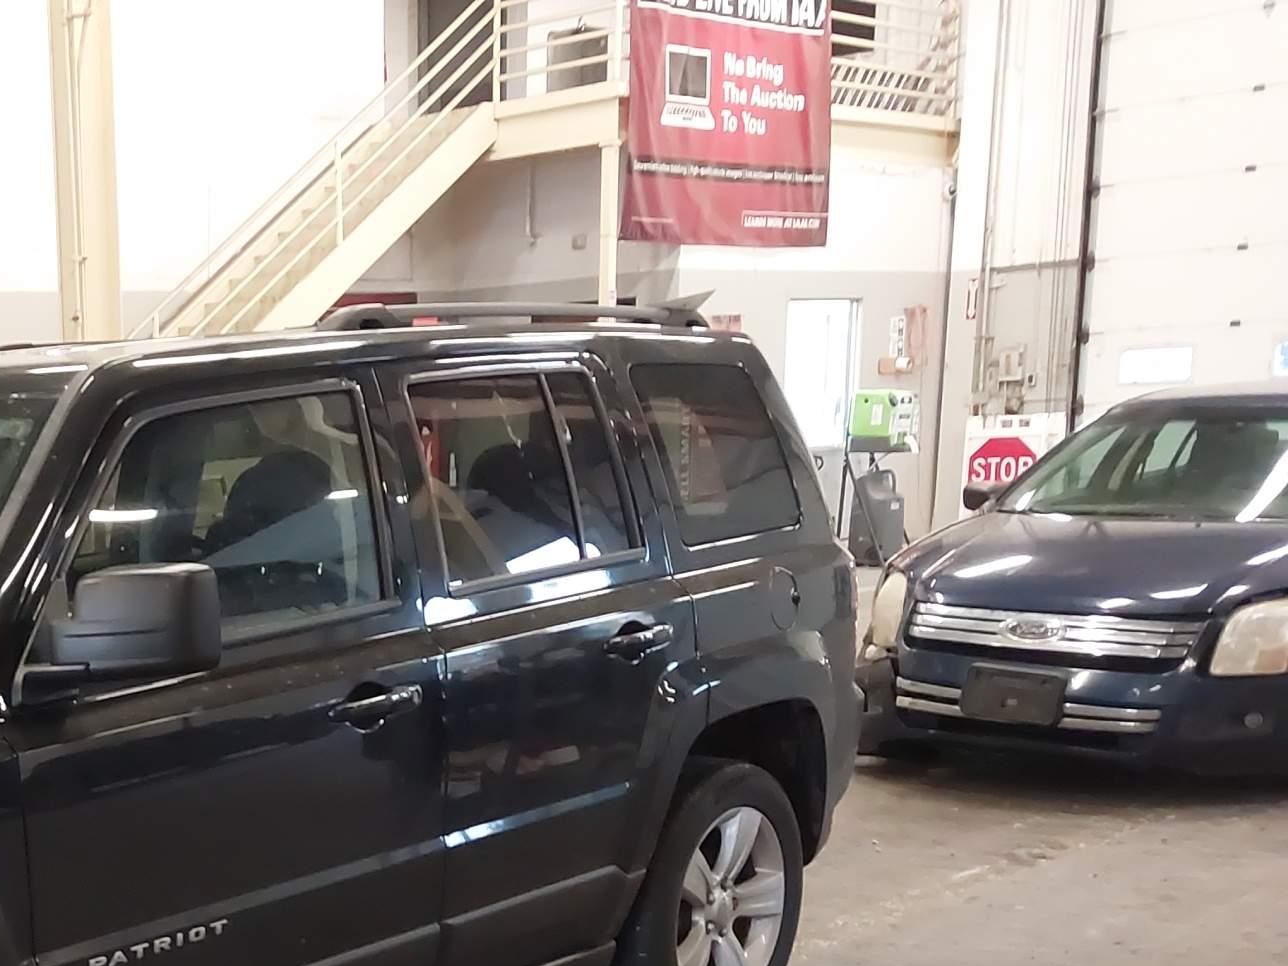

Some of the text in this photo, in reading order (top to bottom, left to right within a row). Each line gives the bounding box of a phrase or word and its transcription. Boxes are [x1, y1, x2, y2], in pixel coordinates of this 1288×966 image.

[745, 55, 785, 87] Bring
[722, 80, 806, 113] The Auction
[720, 109, 767, 136] To You
[971, 455, 1034, 482] STOP
